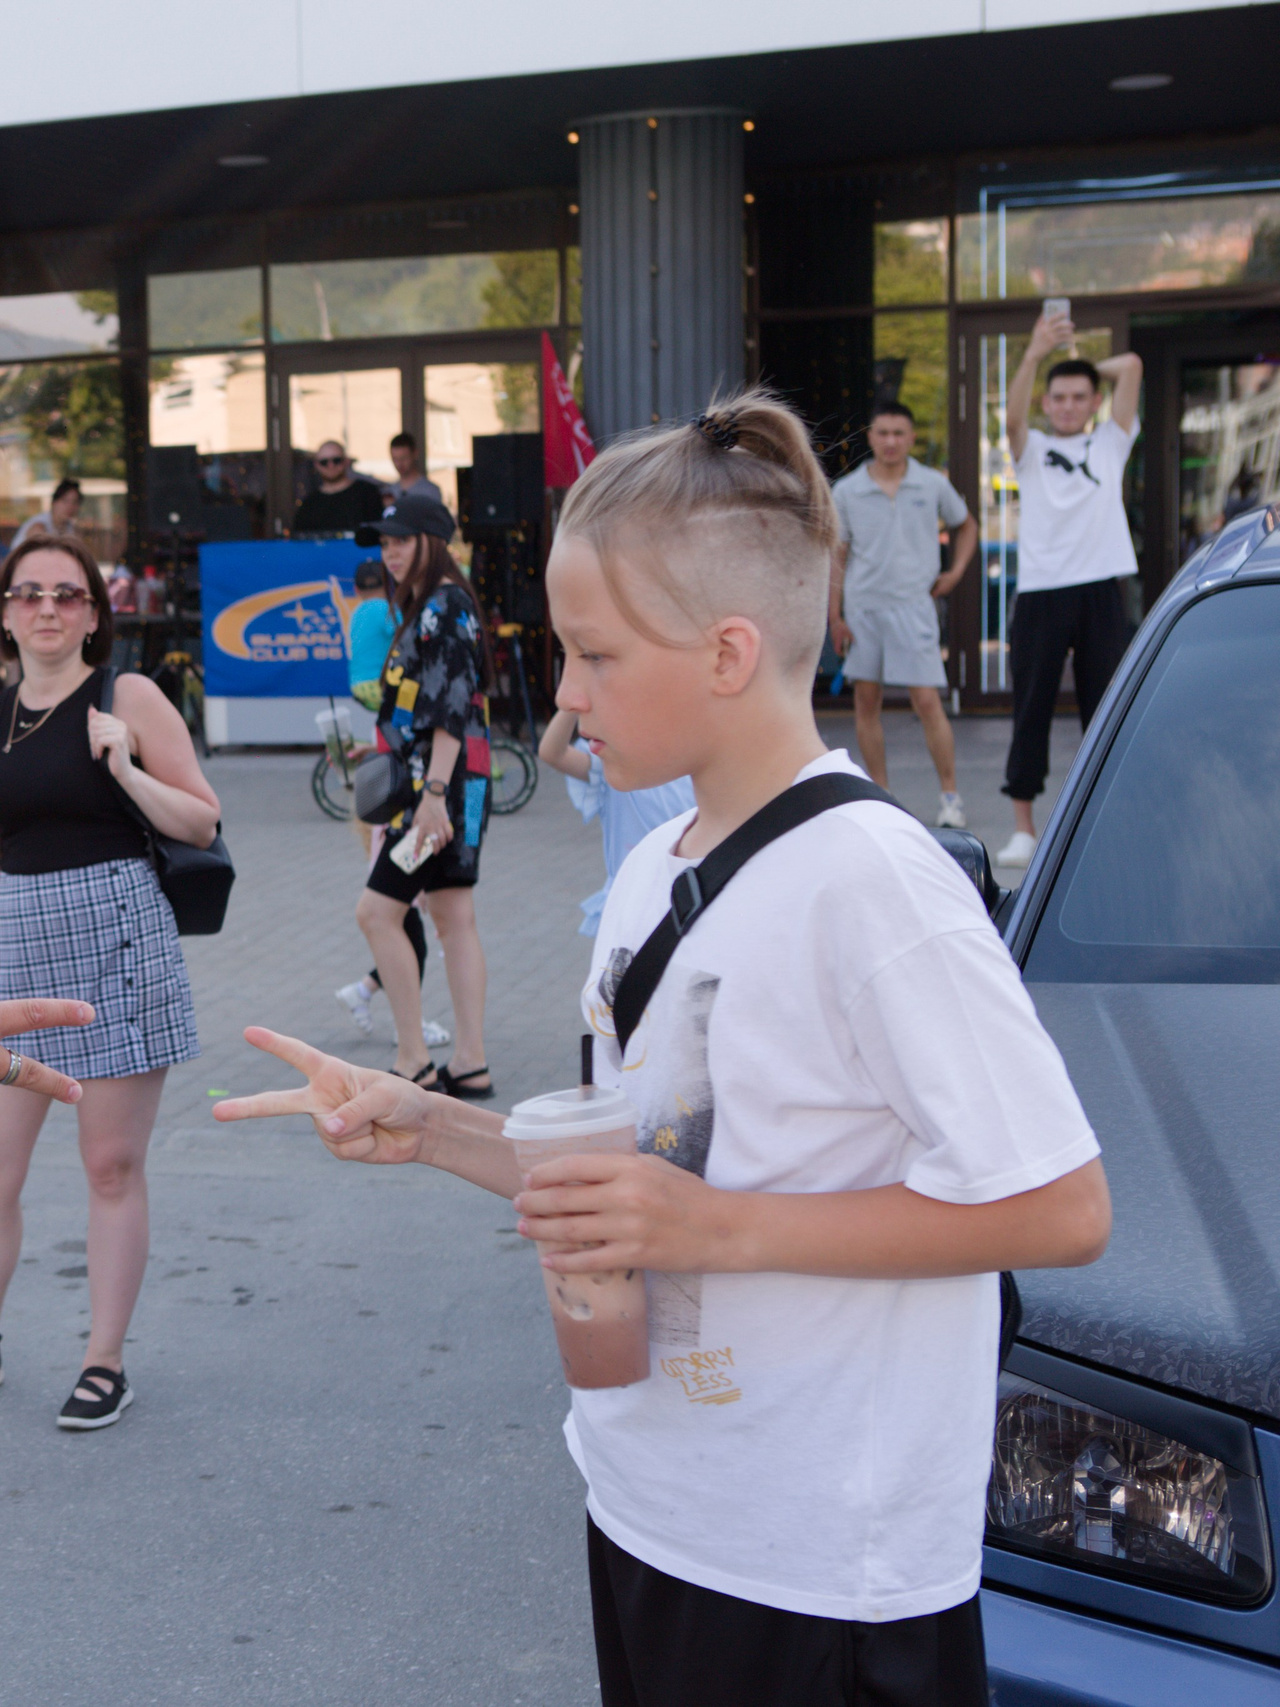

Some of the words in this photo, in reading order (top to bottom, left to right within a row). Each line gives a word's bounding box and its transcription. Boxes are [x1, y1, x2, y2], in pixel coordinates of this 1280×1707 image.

[251, 646, 309, 662] CLUB
[659, 1346, 736, 1379] WORRY
[680, 1371, 733, 1397] LESS
